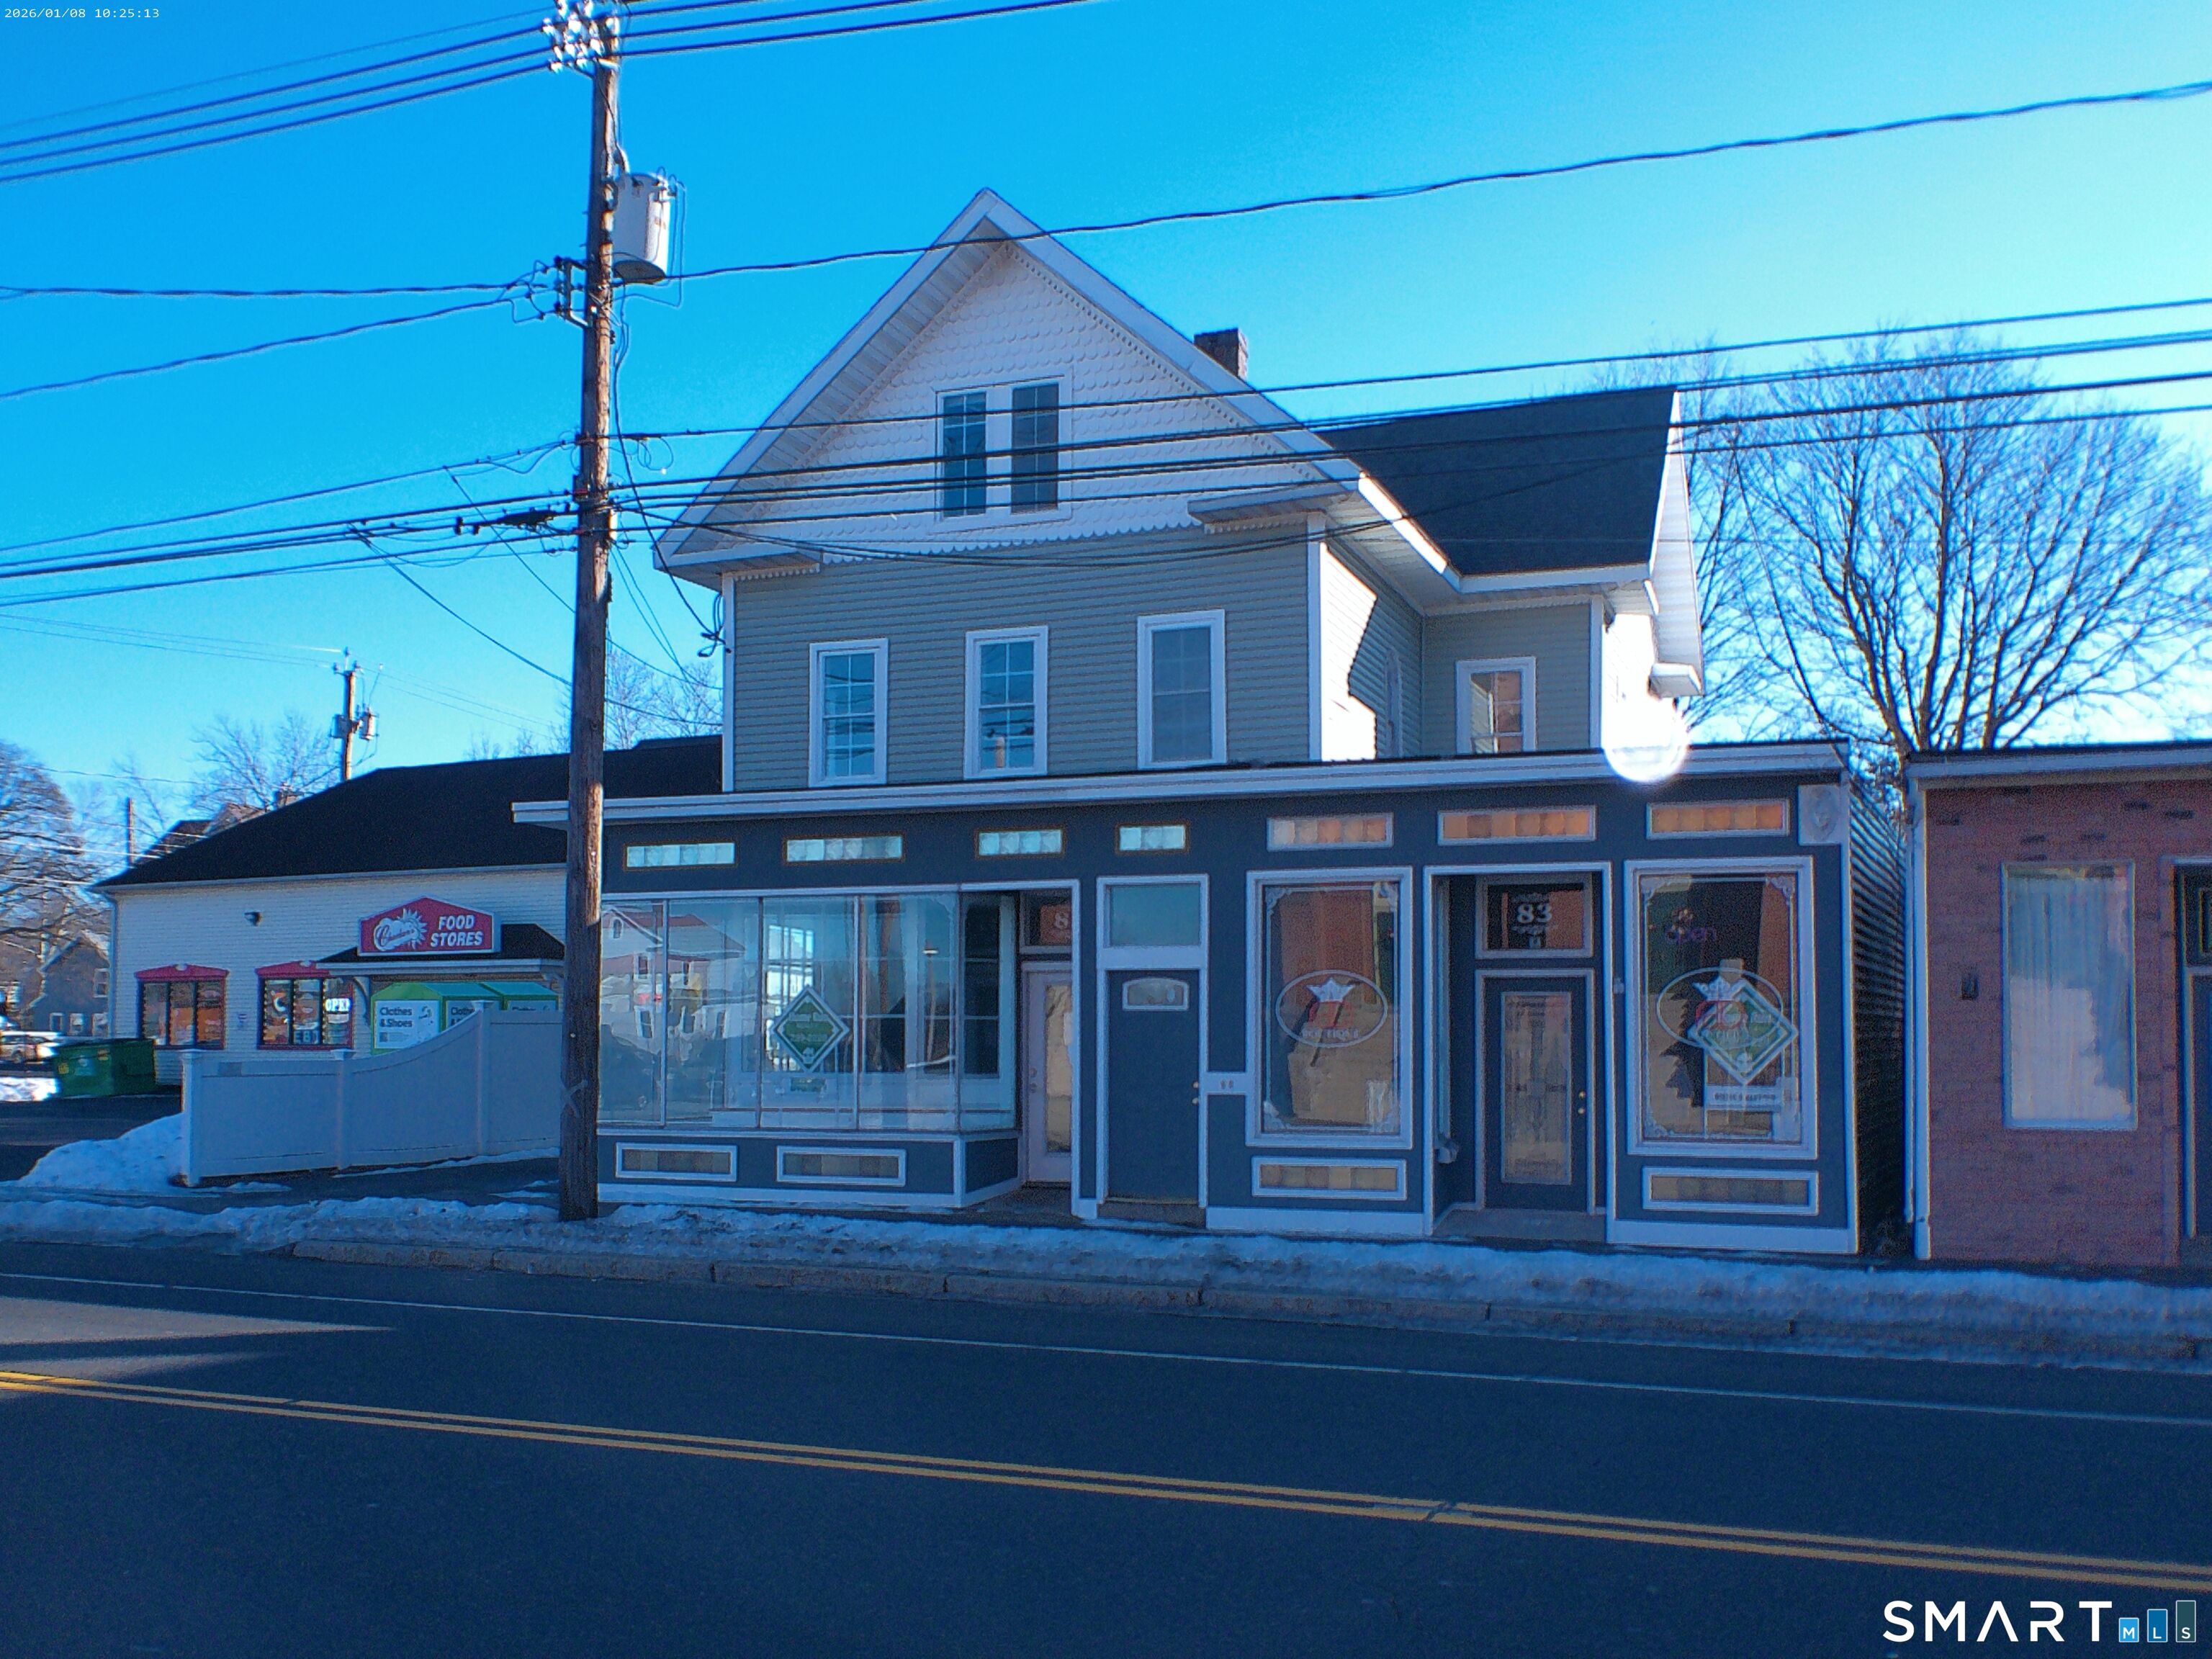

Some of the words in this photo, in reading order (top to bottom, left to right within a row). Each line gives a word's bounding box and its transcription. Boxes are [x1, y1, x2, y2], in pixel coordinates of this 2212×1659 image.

[1516, 903, 1552, 923] 83
[439, 915, 475, 930] FOOD
[431, 931, 483, 948] STORES
[379, 1007, 413, 1016] Clothes
[379, 1019, 387, 1028] &
[388, 1019, 413, 1028] Shoes
